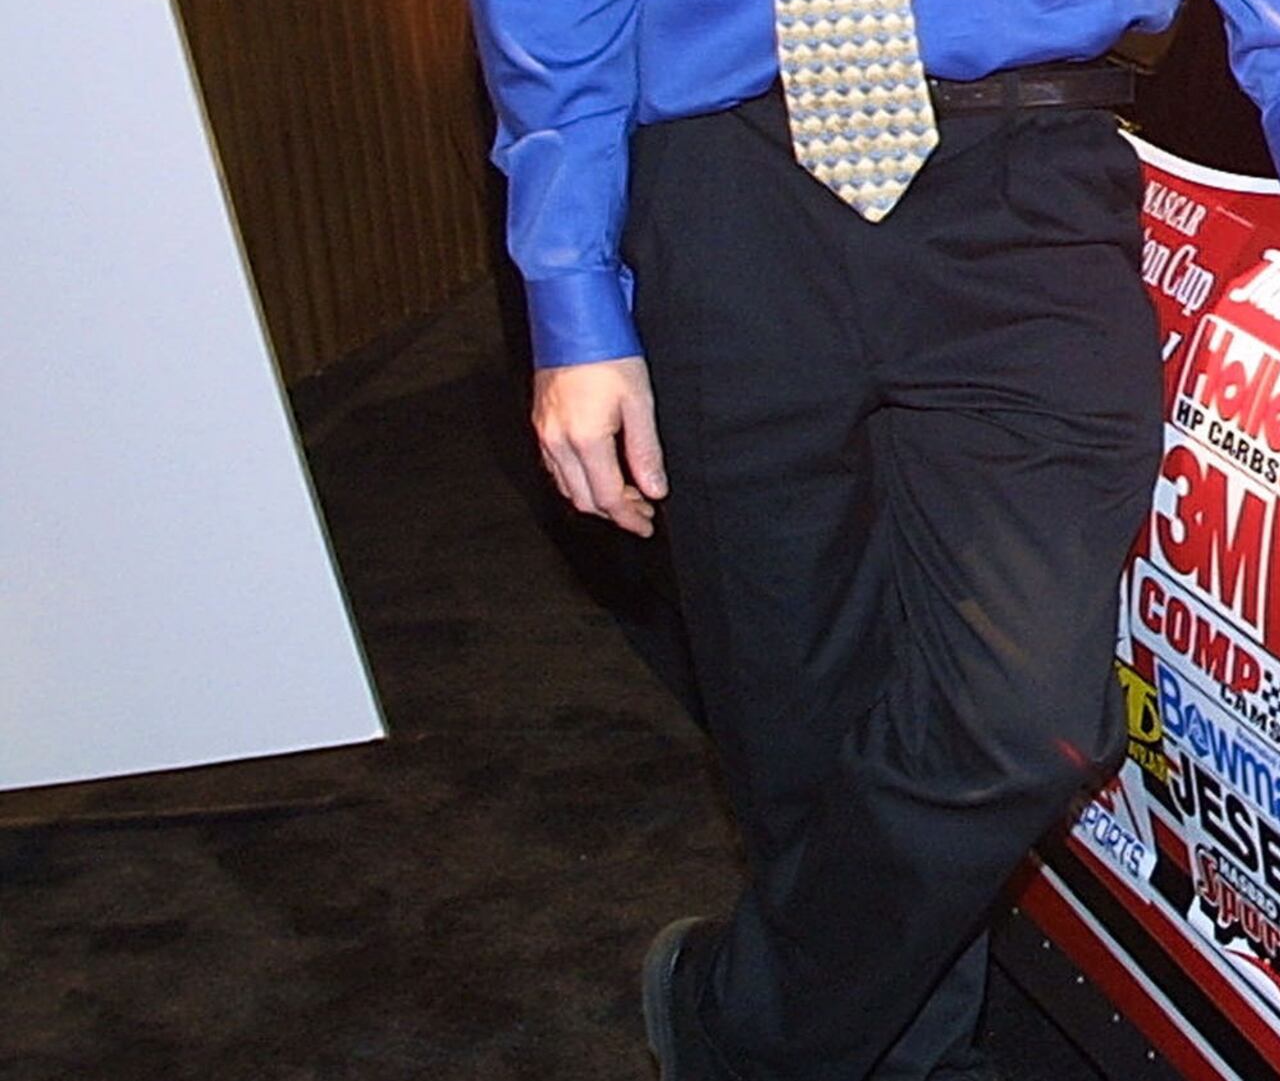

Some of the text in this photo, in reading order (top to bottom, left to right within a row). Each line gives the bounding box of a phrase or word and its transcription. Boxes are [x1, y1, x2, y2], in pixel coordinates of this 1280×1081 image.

[1163, 244, 1215, 318] Cup
[1176, 400, 1280, 484] HP CARBS
[1156, 444, 1267, 631] 3M
[1138, 576, 1262, 695] COMP
